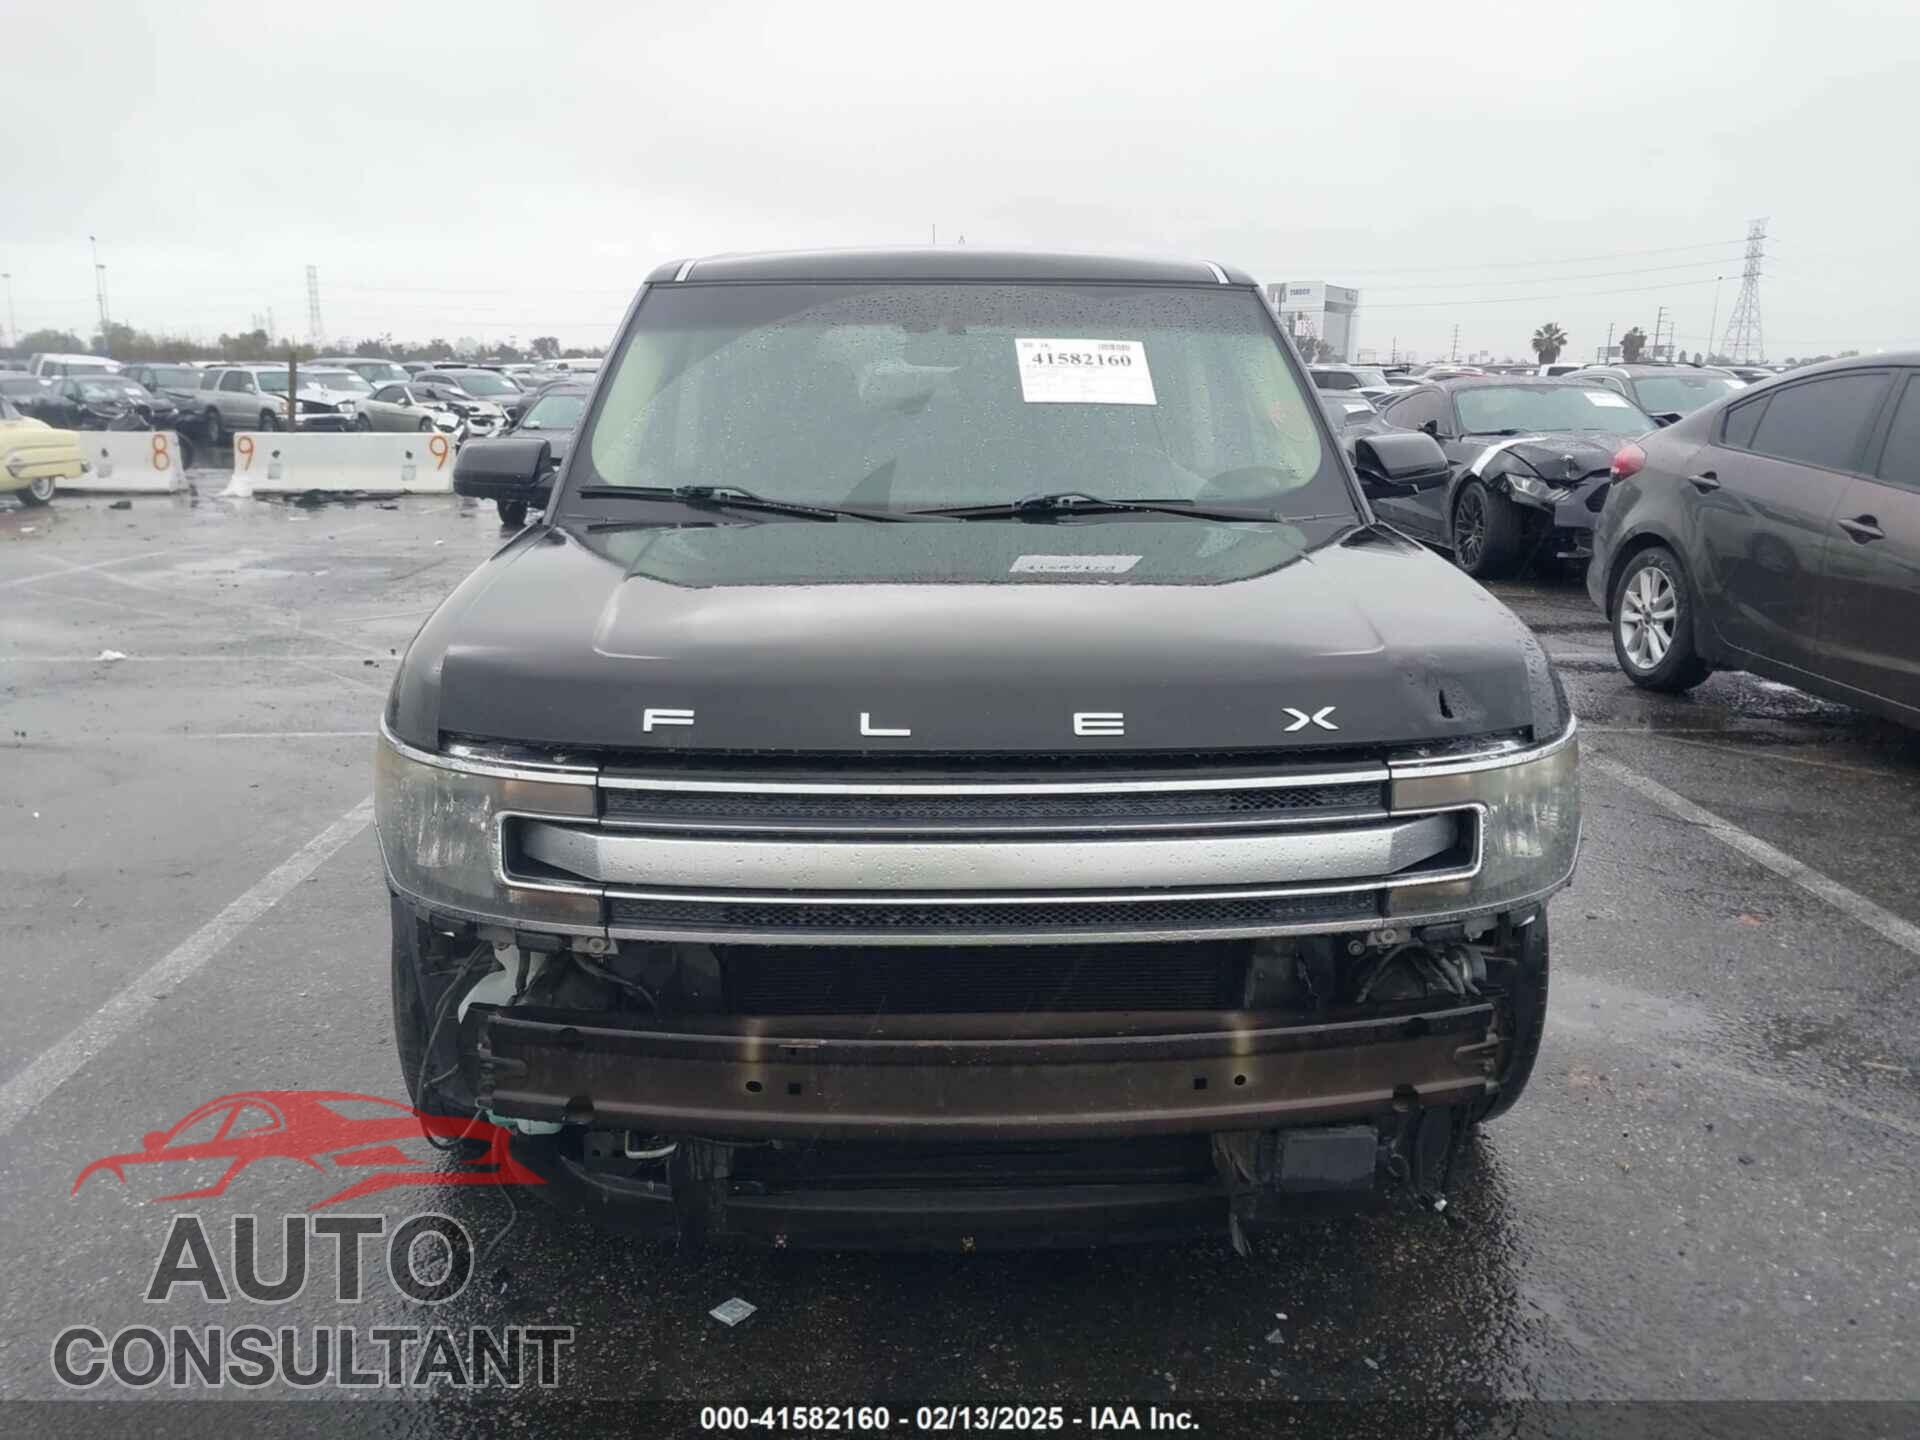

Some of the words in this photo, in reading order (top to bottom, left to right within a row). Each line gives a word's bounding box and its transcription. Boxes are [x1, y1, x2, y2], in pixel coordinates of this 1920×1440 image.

[1032, 353, 1132, 367] 41582160
[152, 434, 170, 471] 8
[238, 435, 256, 471] 9
[429, 434, 450, 471] 9
[642, 706, 1340, 736] FLEX
